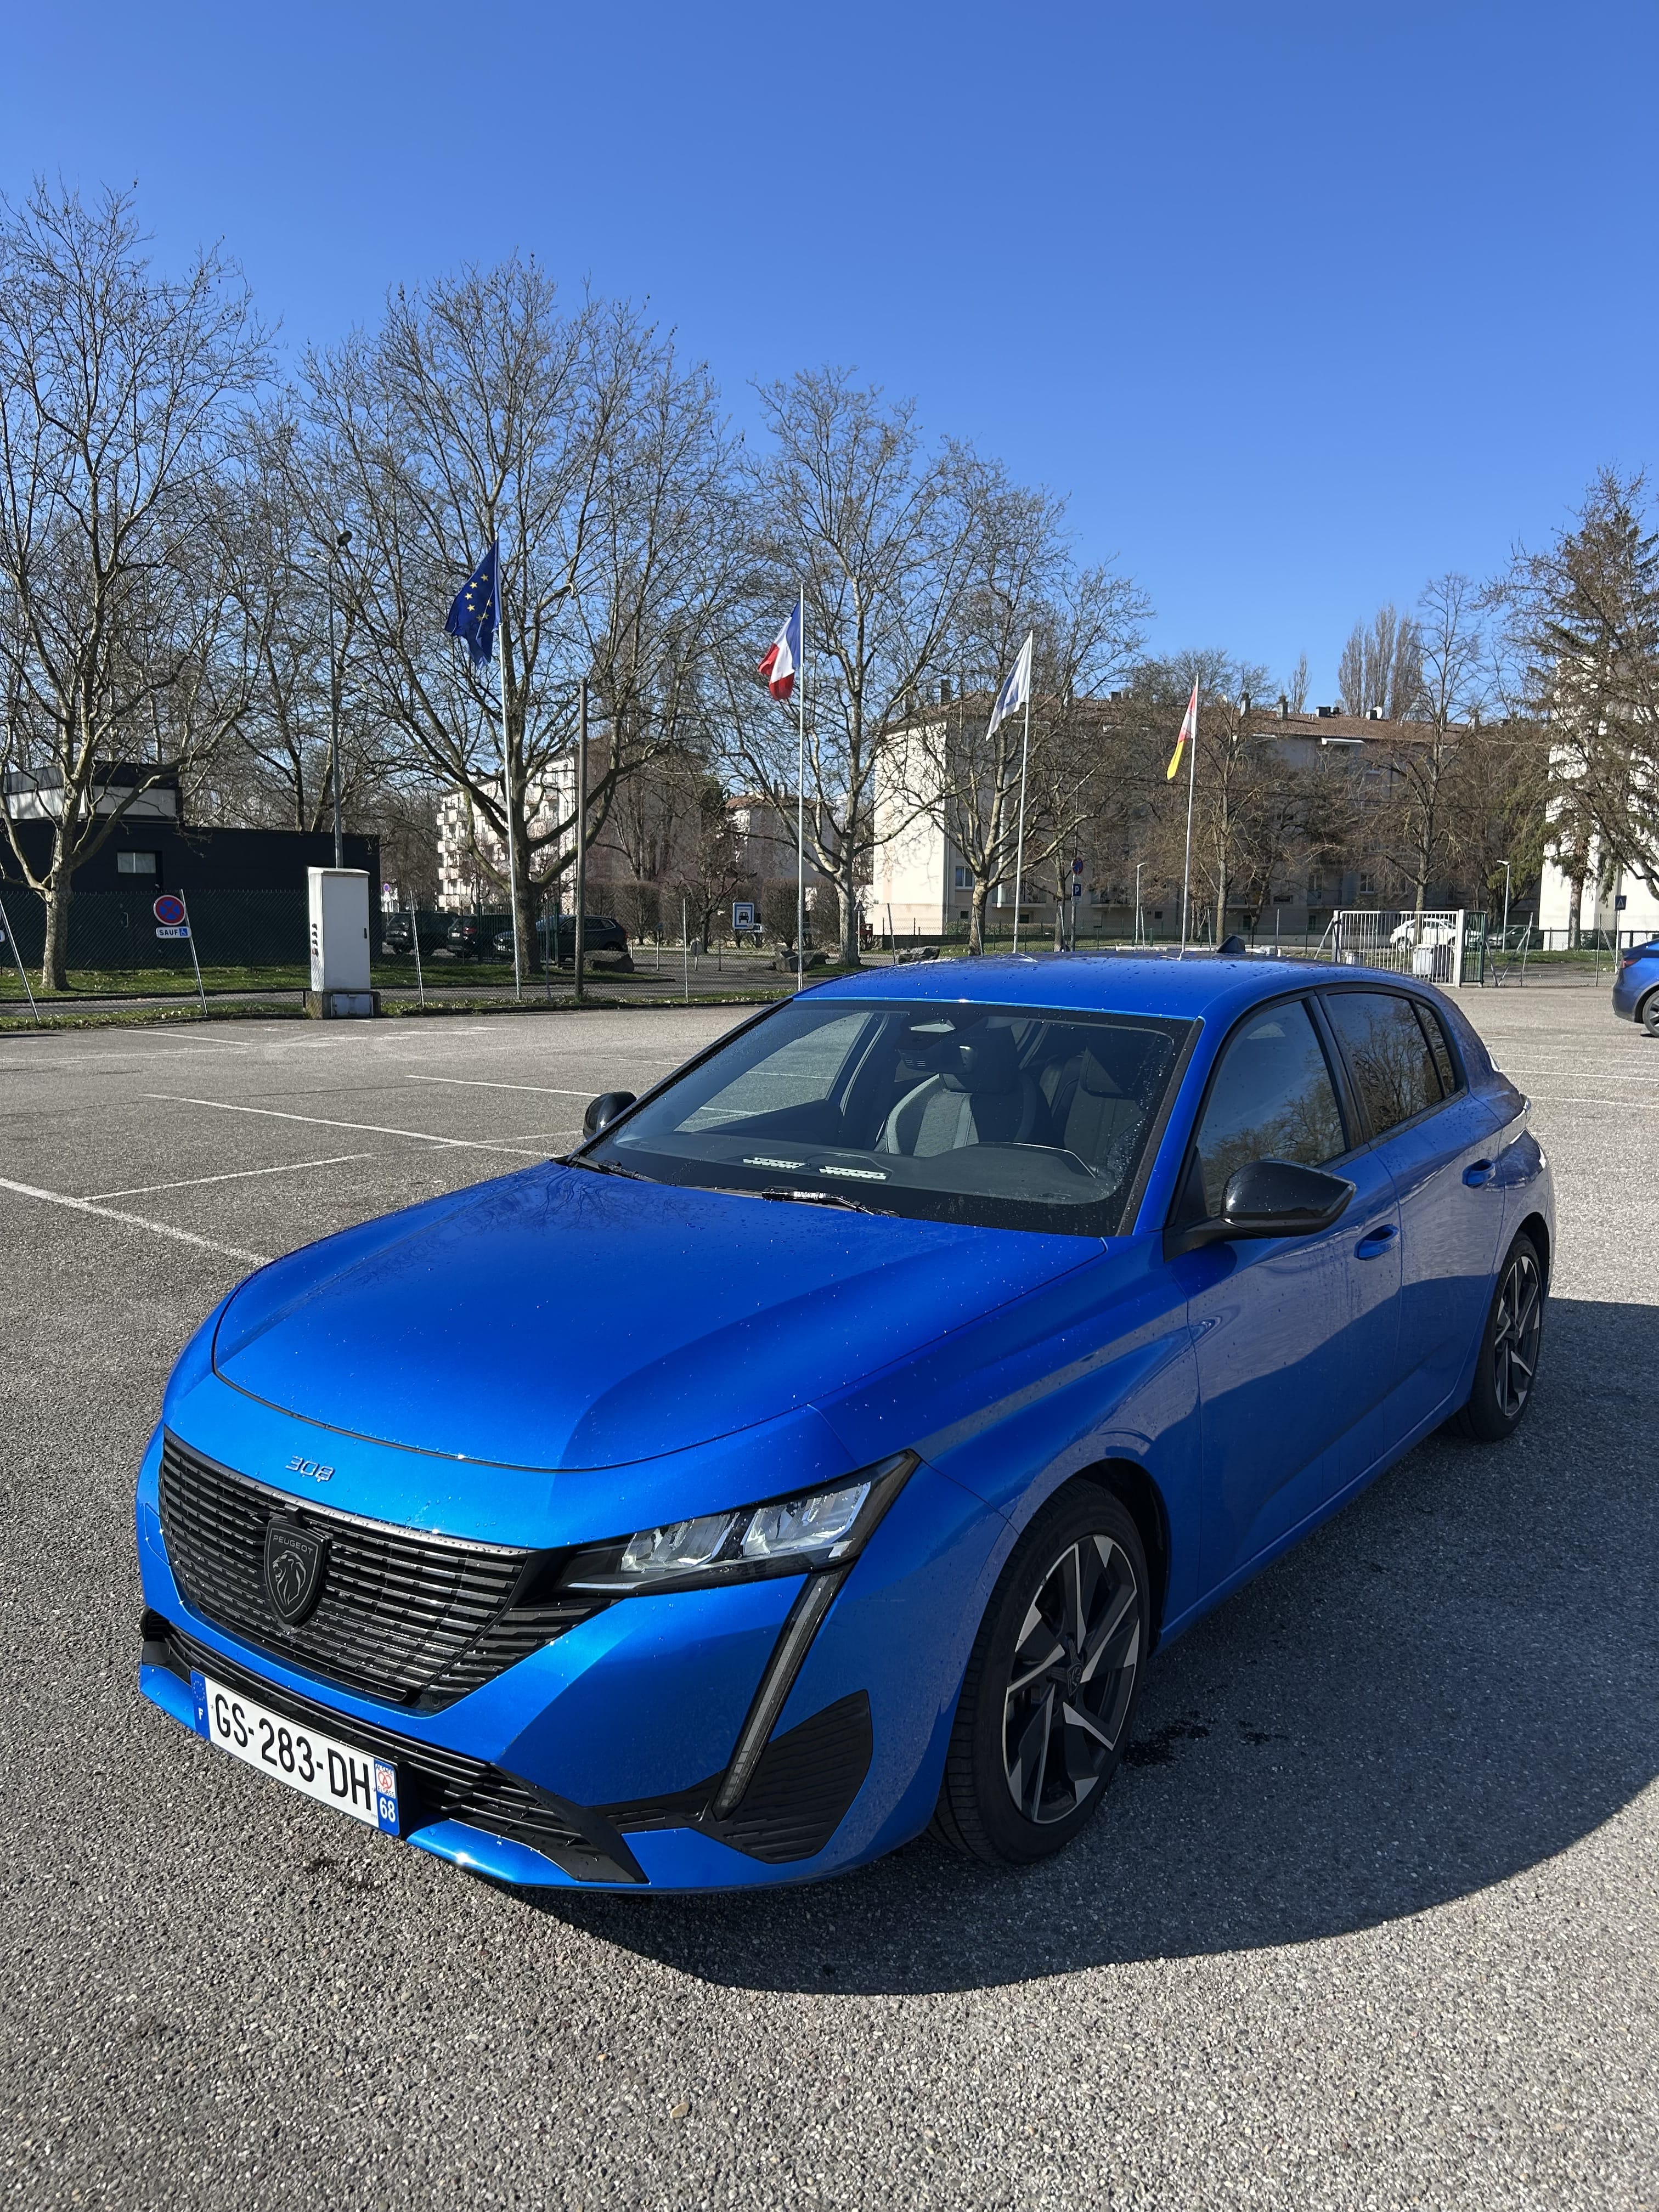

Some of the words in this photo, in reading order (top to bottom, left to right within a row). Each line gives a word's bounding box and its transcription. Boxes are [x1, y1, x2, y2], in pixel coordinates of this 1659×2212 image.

[285, 1455, 334, 1481] 308
[273, 1534, 313, 1555] PEUGEOT
[198, 1707, 204, 1720] F
[215, 1694, 371, 1811] GS-283-DH
[376, 1764, 393, 1776] ALSACE
[378, 1786, 395, 1798] ELSASS
[380, 1797, 396, 1822] 68
